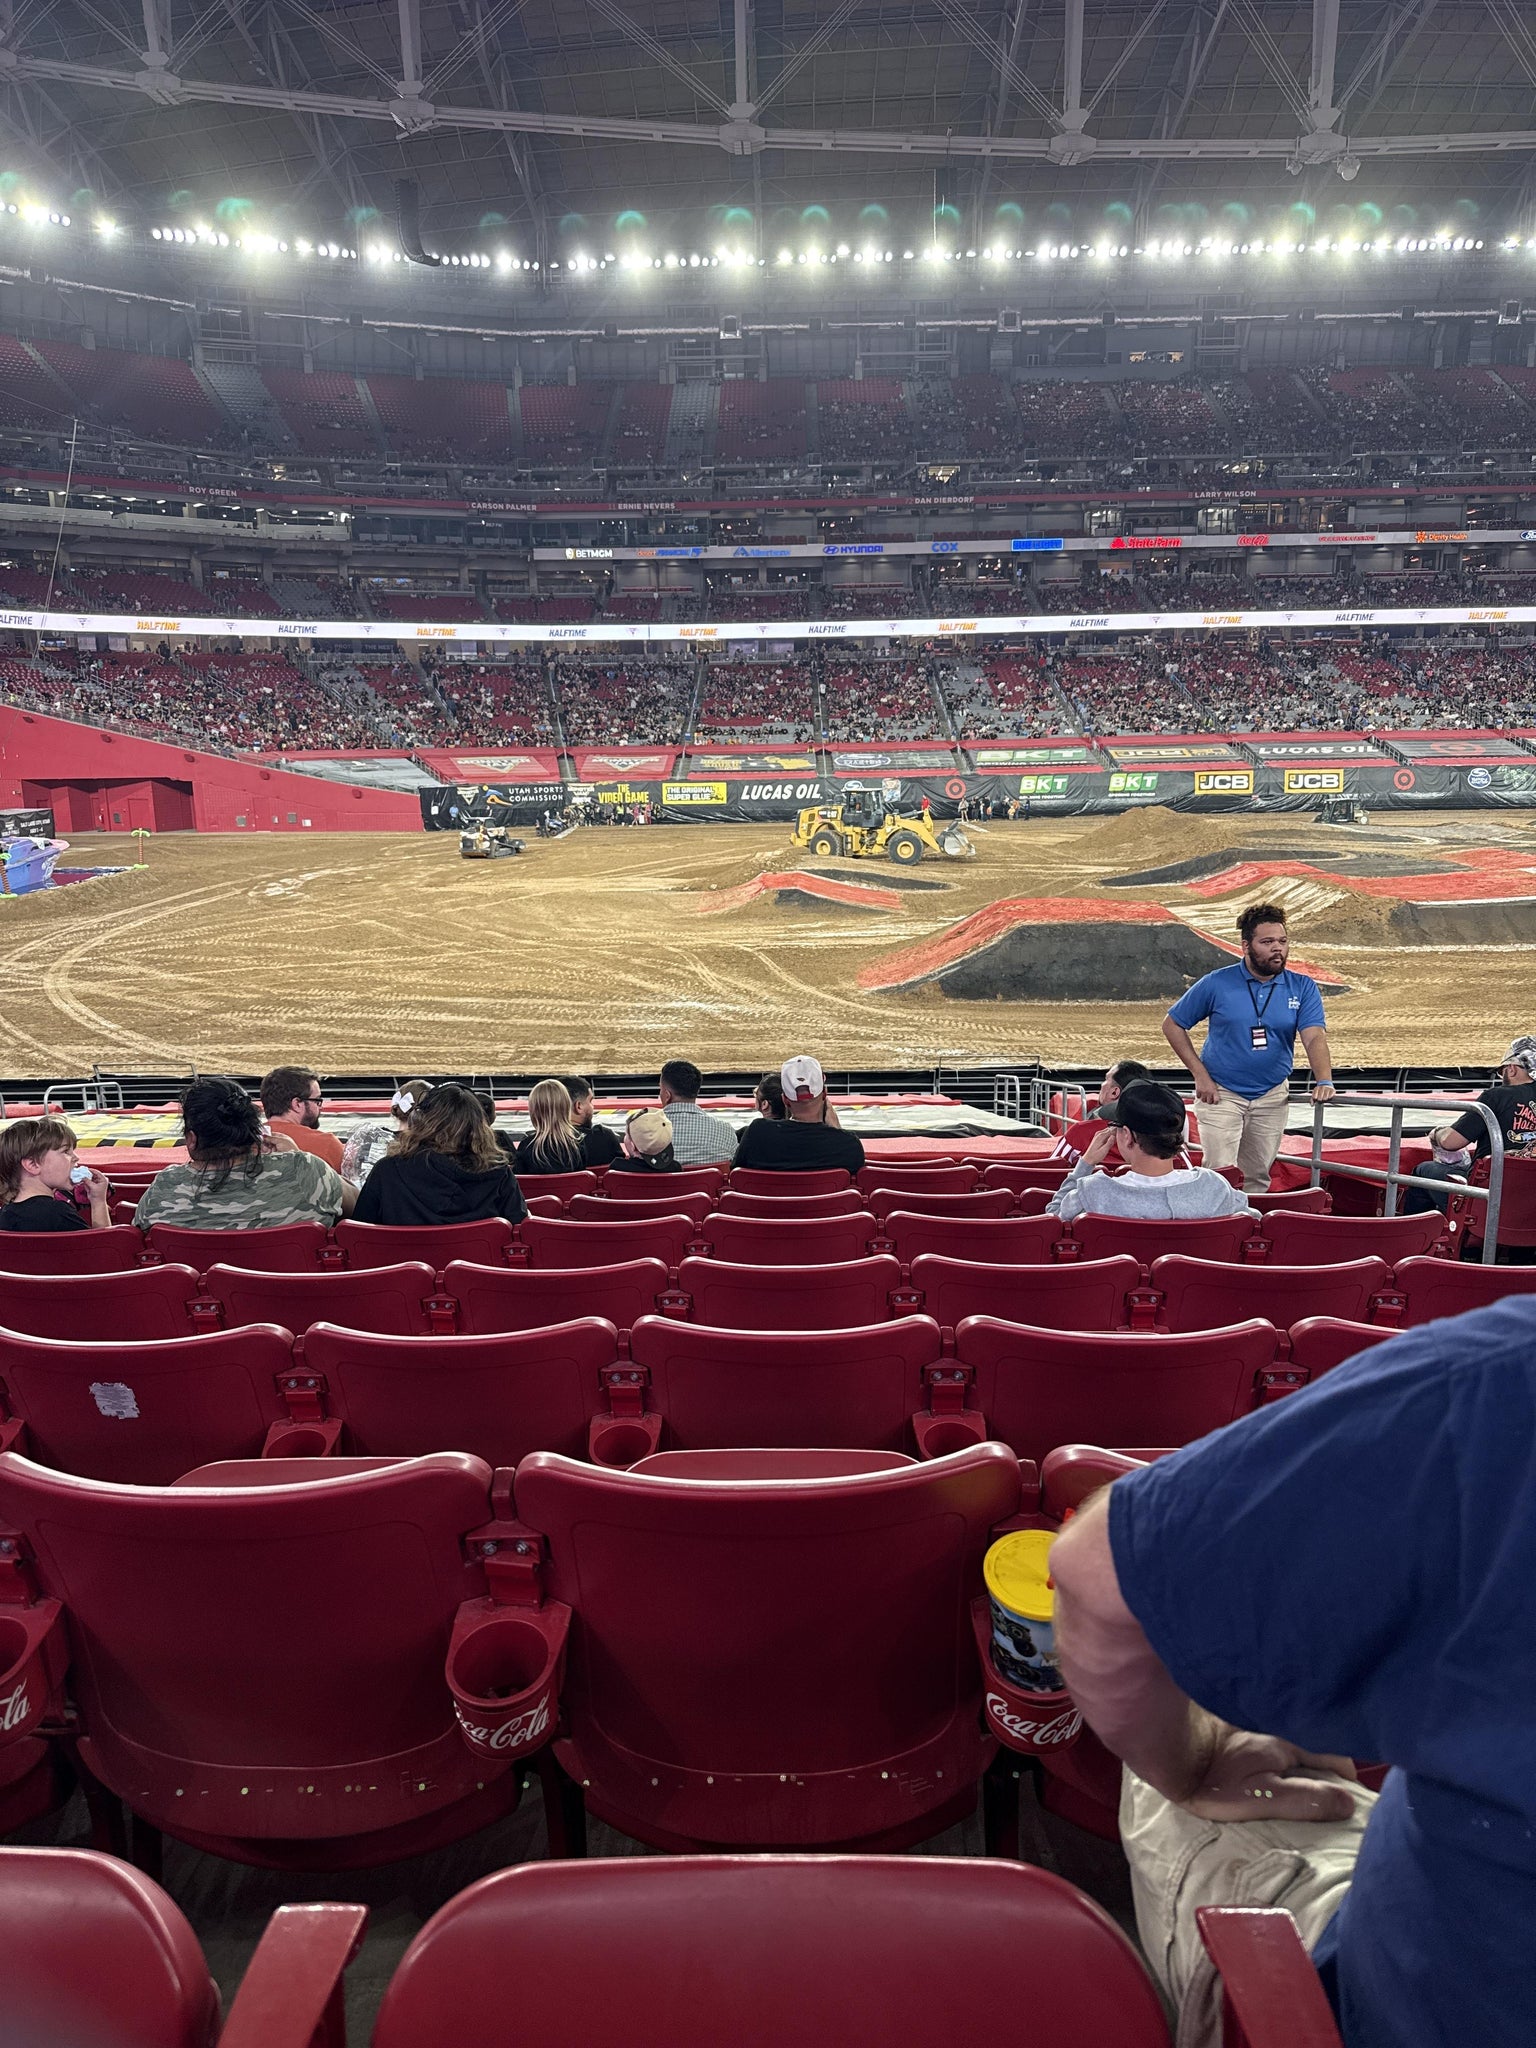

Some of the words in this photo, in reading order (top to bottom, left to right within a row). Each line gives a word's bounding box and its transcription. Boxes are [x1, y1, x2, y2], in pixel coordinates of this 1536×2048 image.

[209, 489, 237, 497] GREEN
[934, 496, 975, 504] DIERDORF
[471, 502, 505, 510] CARSON
[506, 503, 537, 511] PALMER
[1127, 537, 1154, 548] State
[1155, 535, 1182, 547] Farm
[1429, 532, 1449, 542] Dignity
[1450, 532, 1468, 541] Health
[840, 545, 884, 554] HYUNDAI
[931, 542, 958, 553] COX
[575, 549, 613, 559] BETMGM
[0, 614, 33, 626] ALFTIME
[1202, 615, 1243, 625] HALFTIME
[1335, 612, 1375, 622] HALFTIME
[1467, 611, 1509, 620] HALFTIME
[136, 620, 181, 631] HALFTIME
[938, 622, 978, 632] HALFTIME
[1070, 618, 1110, 627] HALFTIME
[278, 624, 317, 634] HALFTIME
[417, 627, 457, 637] HALFTIME
[548, 628, 587, 637] HALFTIME
[680, 628, 718, 636] HALFTIME
[808, 624, 847, 634] HALFTIME
[980, 749, 1083, 759] BKT
[1258, 746, 1335, 755] LUCAS
[1341, 745, 1380, 753] OIL
[1020, 778, 1068, 790] BKT
[1110, 776, 1157, 788] BKT
[1199, 775, 1249, 790] JCB
[1288, 774, 1340, 789] JCB
[508, 787, 530, 795] UTAH
[533, 786, 564, 794] SPORTS
[617, 784, 630, 793] THE
[666, 786, 680, 794] THE
[741, 785, 792, 800] LUCAS
[509, 795, 564, 803] COMMISSION
[598, 793, 623, 804] VIDEO
[625, 791, 649, 803] GAME
[666, 793, 691, 801] SUPER
[692, 793, 711, 801] GLUE
